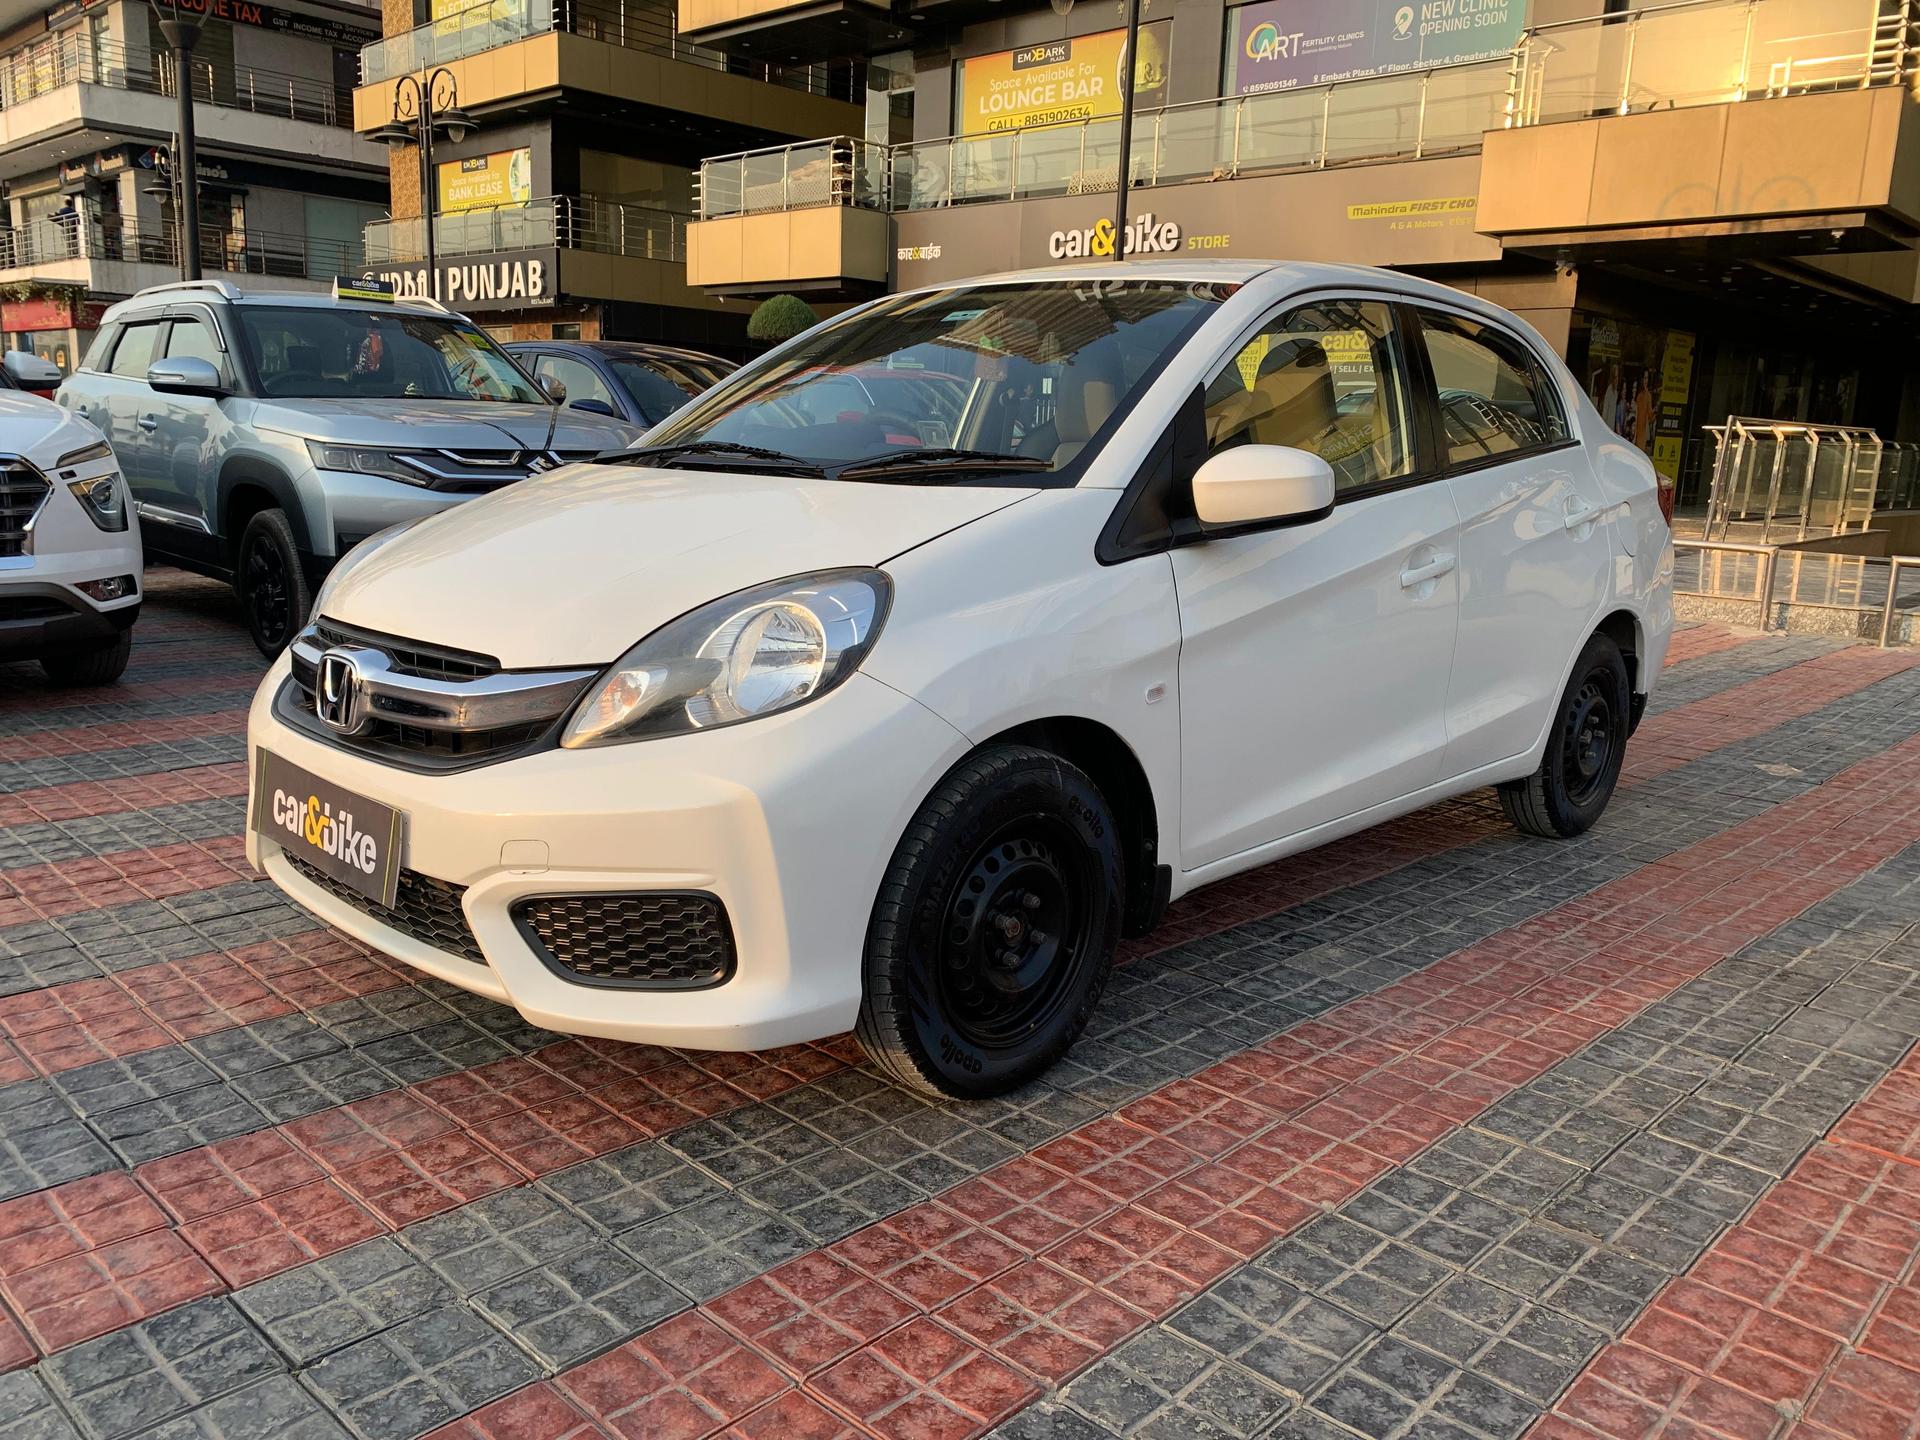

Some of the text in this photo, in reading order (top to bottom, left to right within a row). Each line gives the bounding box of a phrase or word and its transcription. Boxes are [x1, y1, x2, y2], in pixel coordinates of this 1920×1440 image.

[232, 2, 262, 24] TAX
[1419, 9, 1508, 36] OPENING SOON
[1422, 0, 1455, 20] NEW
[293, 21, 323, 35] INCOME
[1256, 31, 1365, 62] ART FERTILITY CLINICS
[1320, 70, 1352, 82] Embark
[1412, 58, 1443, 70] Sector
[1453, 50, 1488, 64] Greater
[1489, 46, 1512, 58] Noid
[990, 63, 1097, 93] Space Available For
[1249, 78, 1298, 93] 8595051349
[979, 76, 1104, 114] LOUNGE BAR
[988, 117, 1015, 131] CALL
[1024, 106, 1091, 126] 8851902634
[448, 181, 503, 201] BANK LEASE
[1352, 205, 1407, 217] Mahindra
[1409, 201, 1448, 212] FIRST
[1188, 234, 1230, 250] STORE
[448, 260, 544, 301] PUNJAB
[1338, 365, 1358, 373] SELL
[273, 788, 377, 875] car&bike
[940, 1033, 983, 1074] apollo
